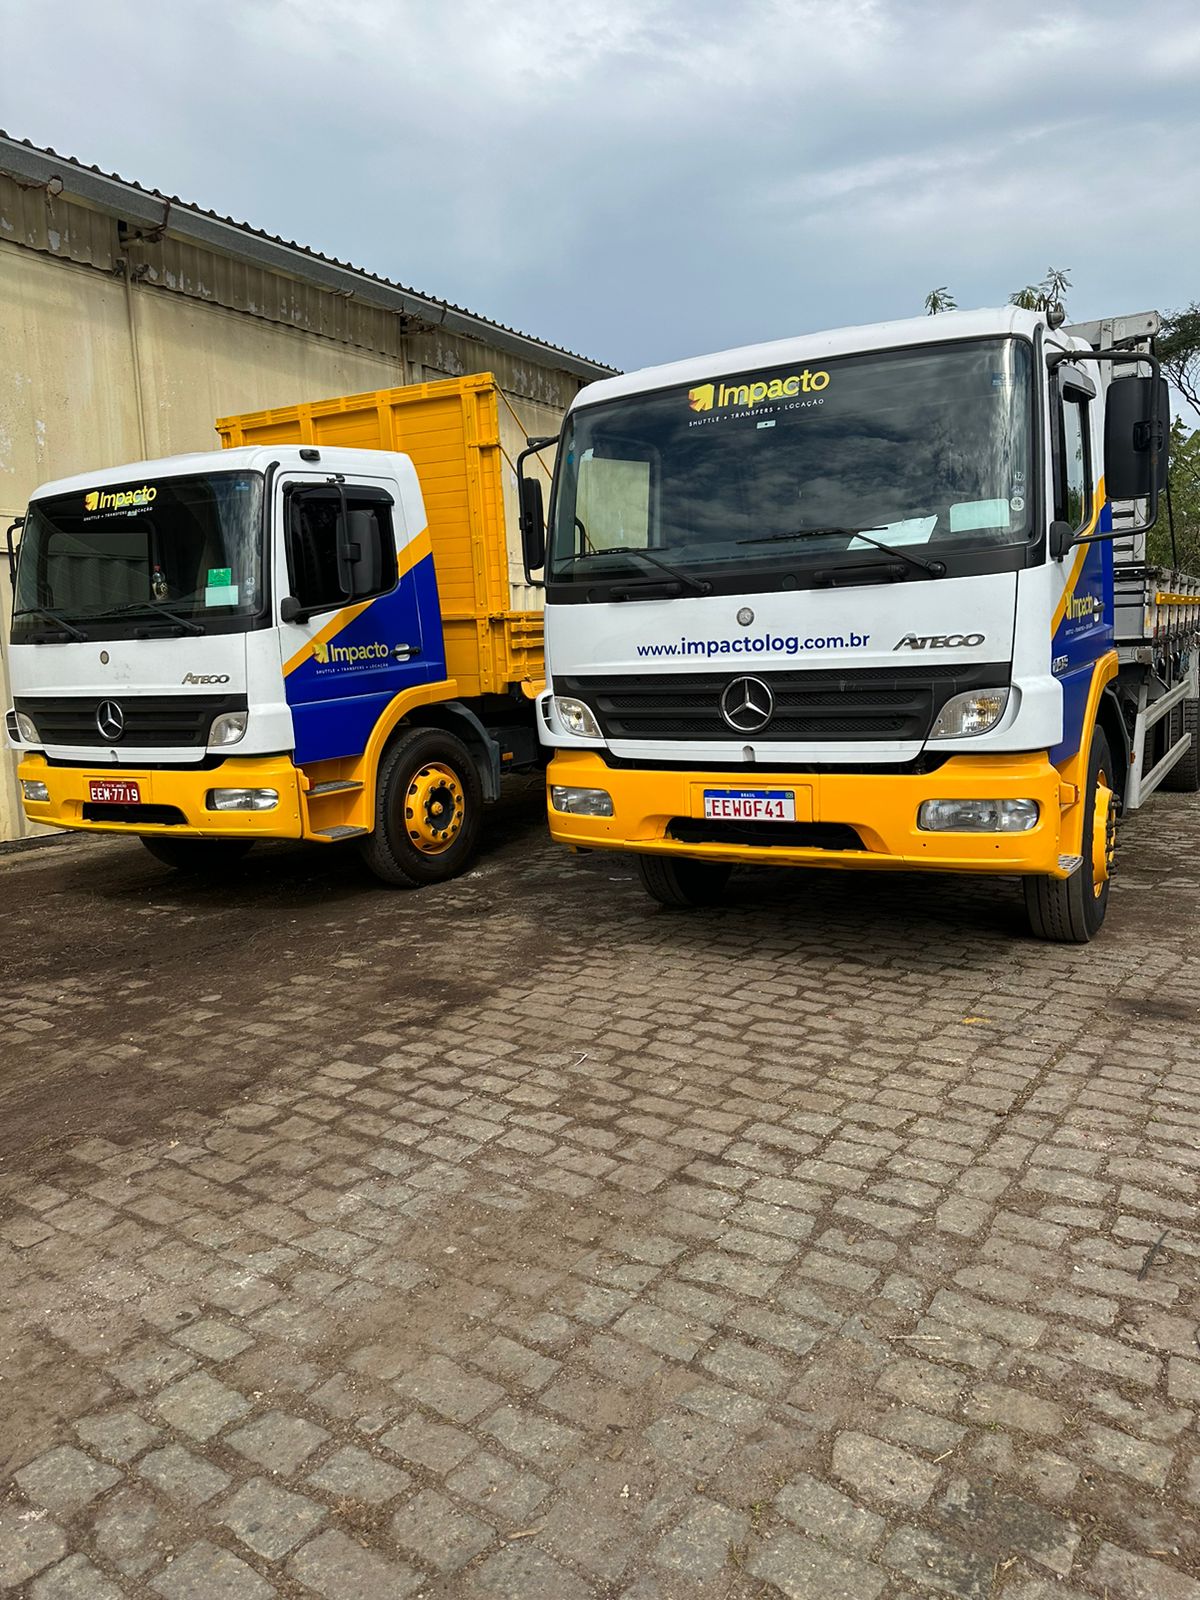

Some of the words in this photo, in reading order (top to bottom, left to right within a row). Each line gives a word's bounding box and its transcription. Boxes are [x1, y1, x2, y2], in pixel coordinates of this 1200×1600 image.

[718, 369, 830, 408] Impacto
[689, 416, 720, 427] SHUTTLE
[731, 406, 773, 419] TRANSFERS
[784, 398, 824, 411] LOCAÇÃO
[99, 485, 157, 510] Impacto
[1071, 592, 1093, 623] Impacto
[330, 641, 389, 665] Impacto
[637, 633, 870, 657] www.impactolog.com.br
[892, 632, 985, 652] ATEGO
[181, 672, 230, 685] ATEGO
